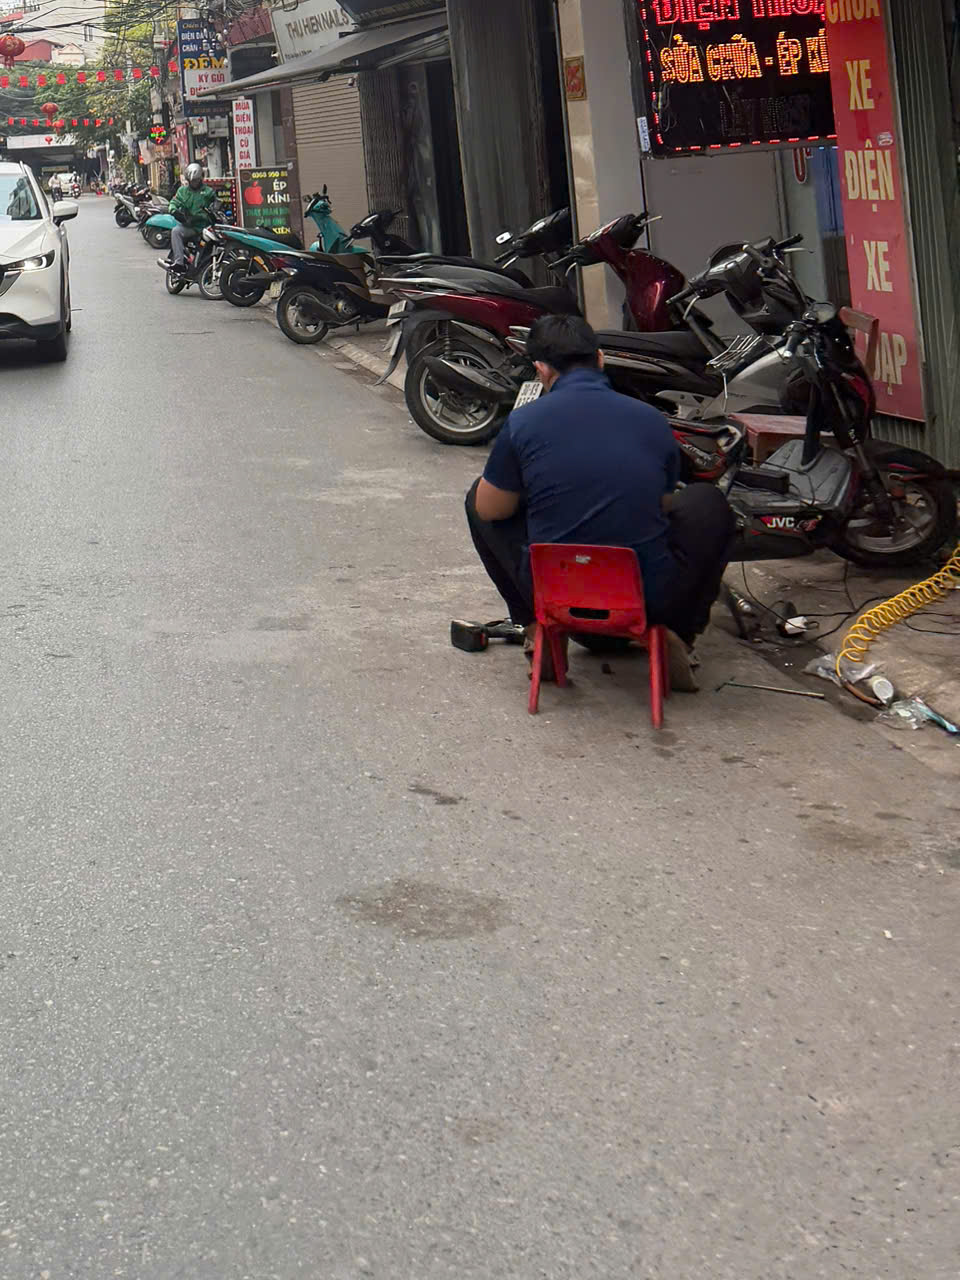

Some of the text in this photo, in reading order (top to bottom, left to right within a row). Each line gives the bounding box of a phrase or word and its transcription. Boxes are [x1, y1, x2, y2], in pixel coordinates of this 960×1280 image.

[659, 33, 705, 84] SỬA
[705, 33, 763, 82] CHỮA
[776, 31, 802, 76] ÉP
[844, 59, 876, 111] XE
[235, 101, 250, 111] MUA
[235, 112, 251, 124] ĐIỆN
[235, 126, 253, 136] THOẠI
[843, 139, 896, 212] ĐIỆN
[273, 179, 287, 191] ÉP
[862, 240, 894, 292] XE
[767, 516, 795, 529] JVC
